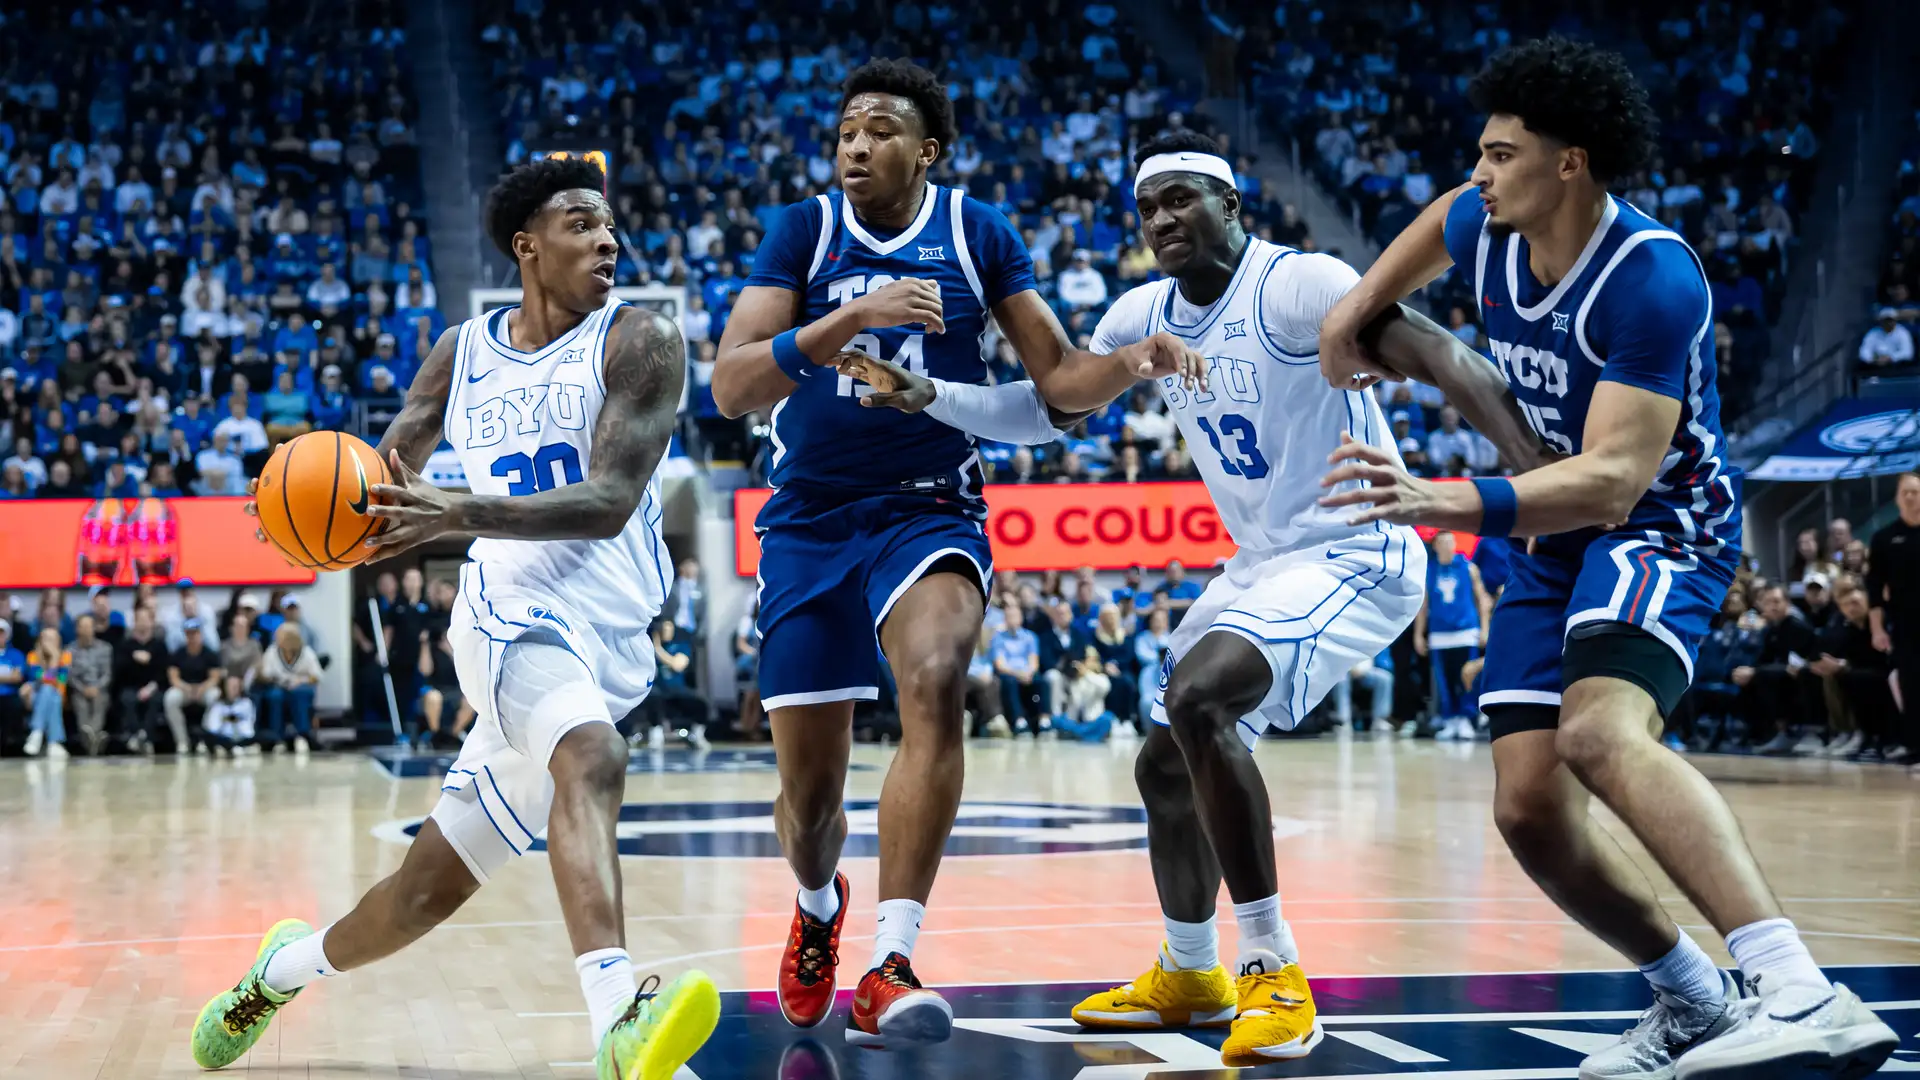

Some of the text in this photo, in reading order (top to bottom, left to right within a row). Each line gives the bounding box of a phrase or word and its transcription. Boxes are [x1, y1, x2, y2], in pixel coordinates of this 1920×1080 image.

[1489, 338, 1568, 398] TCU
[467, 382, 585, 449] BYU
[490, 442, 584, 497] 30
[1197, 414, 1270, 479] 13
[1055, 506, 1233, 545] COUG
